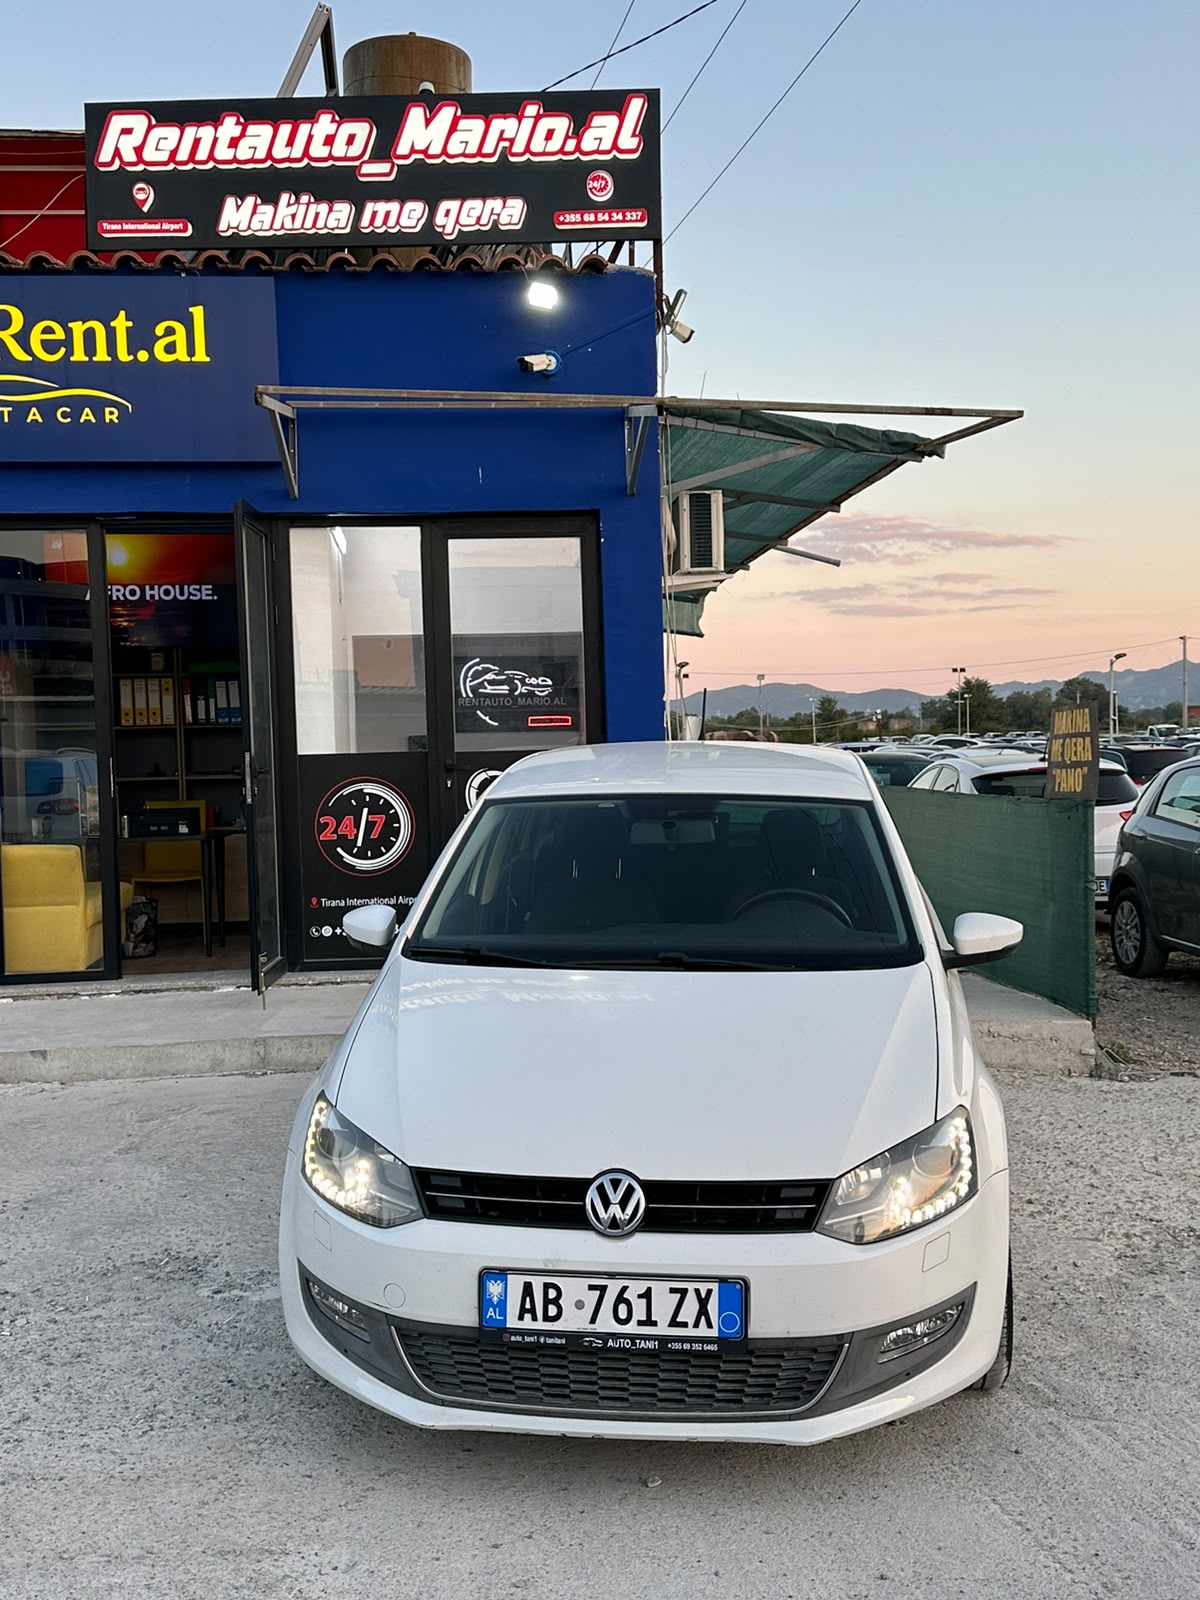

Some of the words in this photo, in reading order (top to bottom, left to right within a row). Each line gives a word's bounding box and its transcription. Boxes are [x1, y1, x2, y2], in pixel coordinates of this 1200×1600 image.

[588, 179, 606, 191] 24/7
[217, 192, 356, 236] Makina
[358, 199, 428, 233] me
[558, 213, 582, 223] +355
[583, 213, 596, 222] 68
[597, 212, 610, 221] 54
[611, 211, 623, 221] 34
[625, 211, 643, 221] 337
[102, 222, 122, 230] Tirana
[122, 222, 161, 230] International
[161, 222, 184, 232] Airport
[145, 584, 218, 601] HOUSE.
[458, 697, 567, 708] RENTAUTO_MARIO.AL
[1064, 736, 1093, 764] QERA
[321, 897, 345, 907] Tirana
[346, 896, 396, 906] International
[517, 1280, 564, 1323] AB
[486, 1307, 504, 1320] AL
[607, 1338, 659, 1350] AUTO_TANI1
